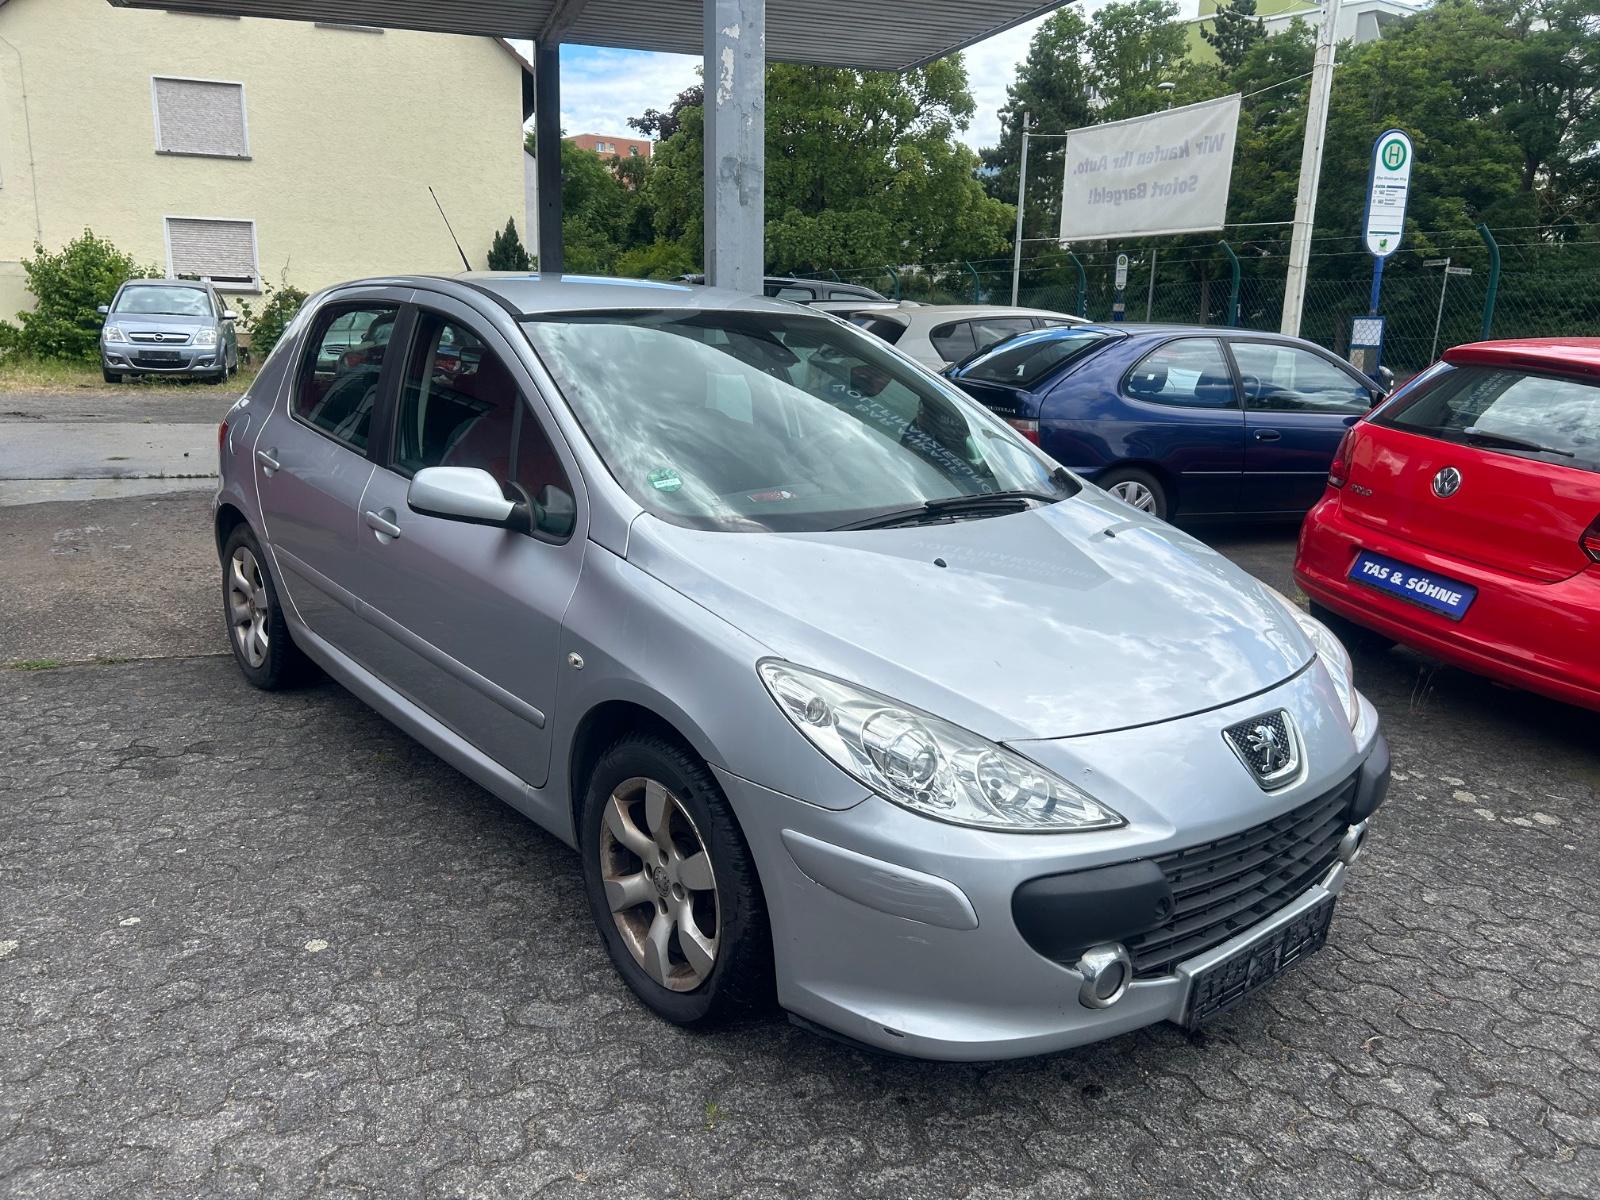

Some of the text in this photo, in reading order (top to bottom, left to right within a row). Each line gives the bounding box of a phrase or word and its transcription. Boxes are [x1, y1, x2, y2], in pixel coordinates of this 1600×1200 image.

[1362, 561, 1462, 606] TAS & SÖHNE
